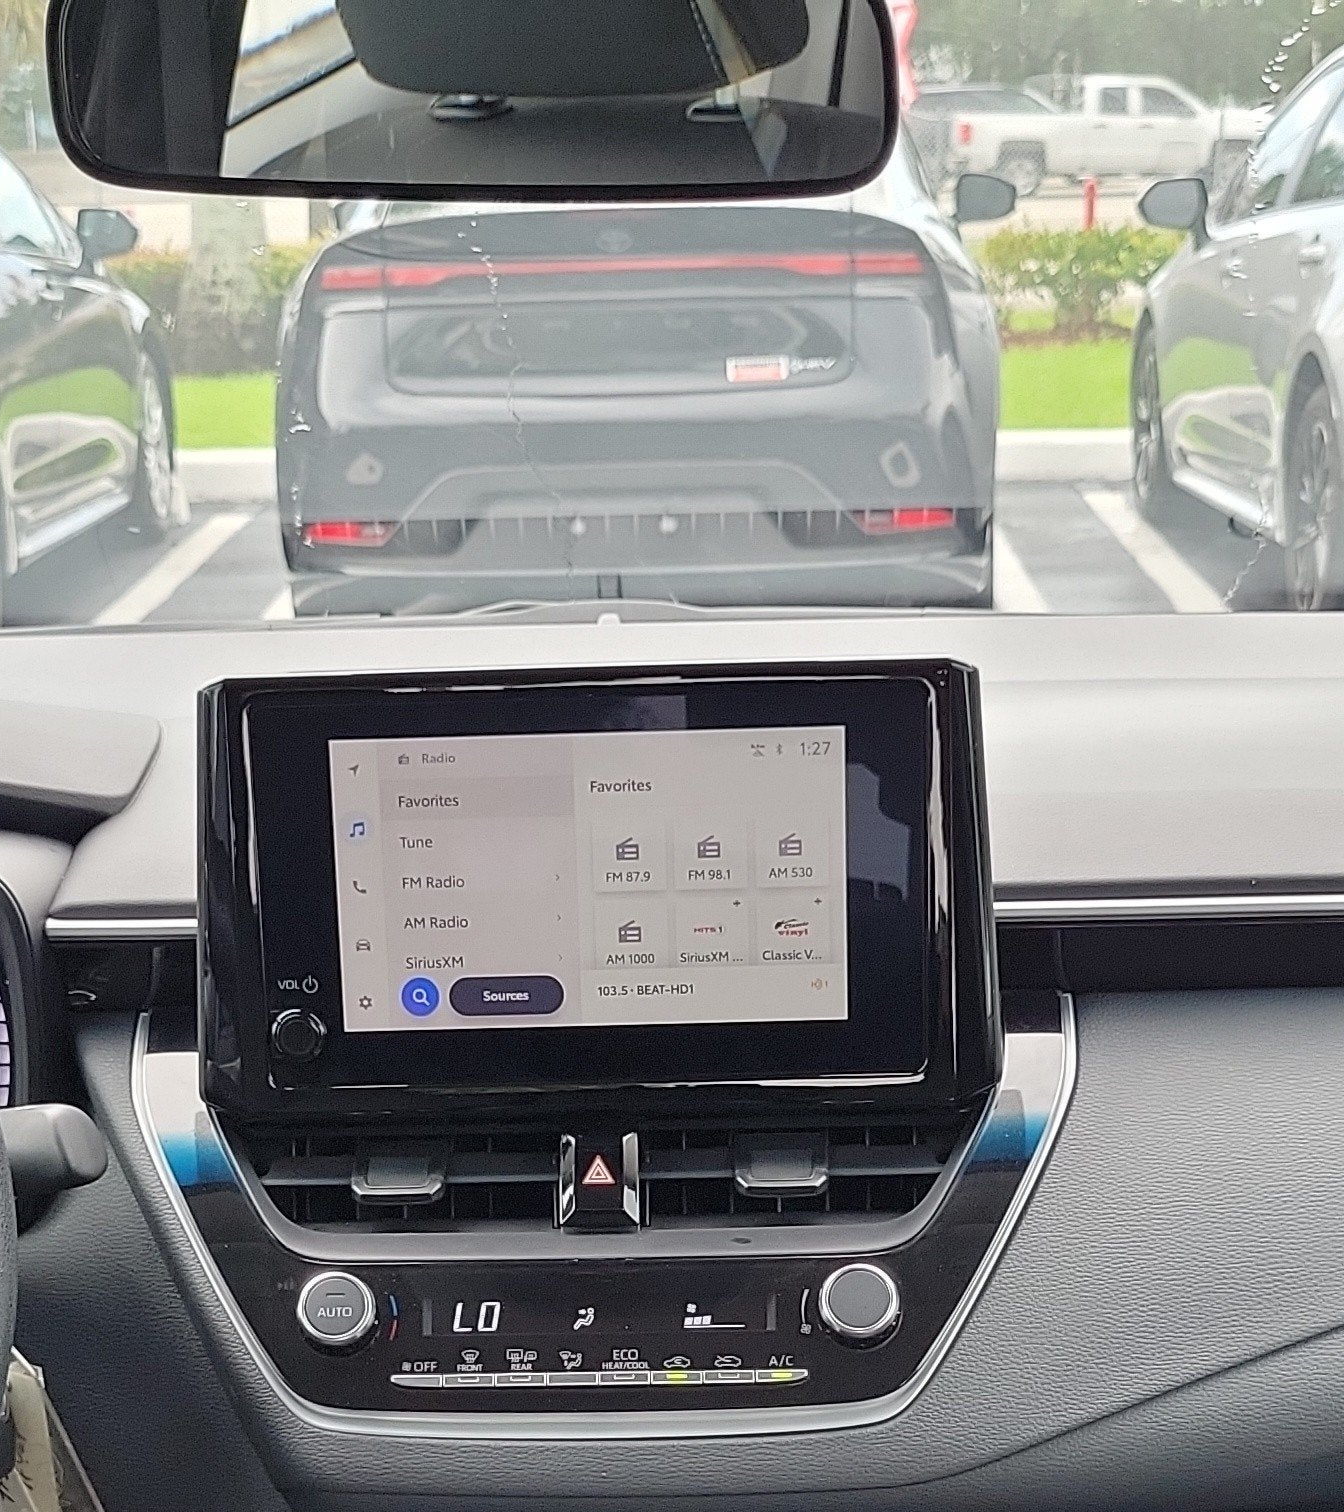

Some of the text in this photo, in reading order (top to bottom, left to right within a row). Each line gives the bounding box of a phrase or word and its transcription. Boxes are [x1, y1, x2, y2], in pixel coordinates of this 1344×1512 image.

[800, 741, 831, 756] 1:27
[421, 753, 456, 764] Radio
[590, 779, 652, 793] Favorites
[398, 794, 459, 808] Favorites
[400, 836, 433, 849] Tune
[606, 871, 651, 883] FM 87.9
[688, 869, 731, 880] FM 98.1
[768, 867, 813, 879] AM 530
[402, 876, 465, 889] FM Radio
[404, 915, 469, 929] AM Radio
[606, 953, 655, 965] AM 1000
[679, 951, 729, 963] SiriusXM
[762, 950, 802, 961] Classic
[405, 956, 464, 969] SiriusXM
[277, 979, 300, 990] VOL
[597, 984, 694, 996] 103.5 BEAT-HD1
[483, 990, 529, 1002] Sources
[317, 1307, 353, 1318] AUTO
[612, 1349, 639, 1361] ECO
[768, 1355, 794, 1366] A/C
[413, 1361, 438, 1372] OFF
[456, 1363, 483, 1372] FRONT
[511, 1363, 532, 1371] REAR
[601, 1361, 650, 1370] HEAT/COOL
